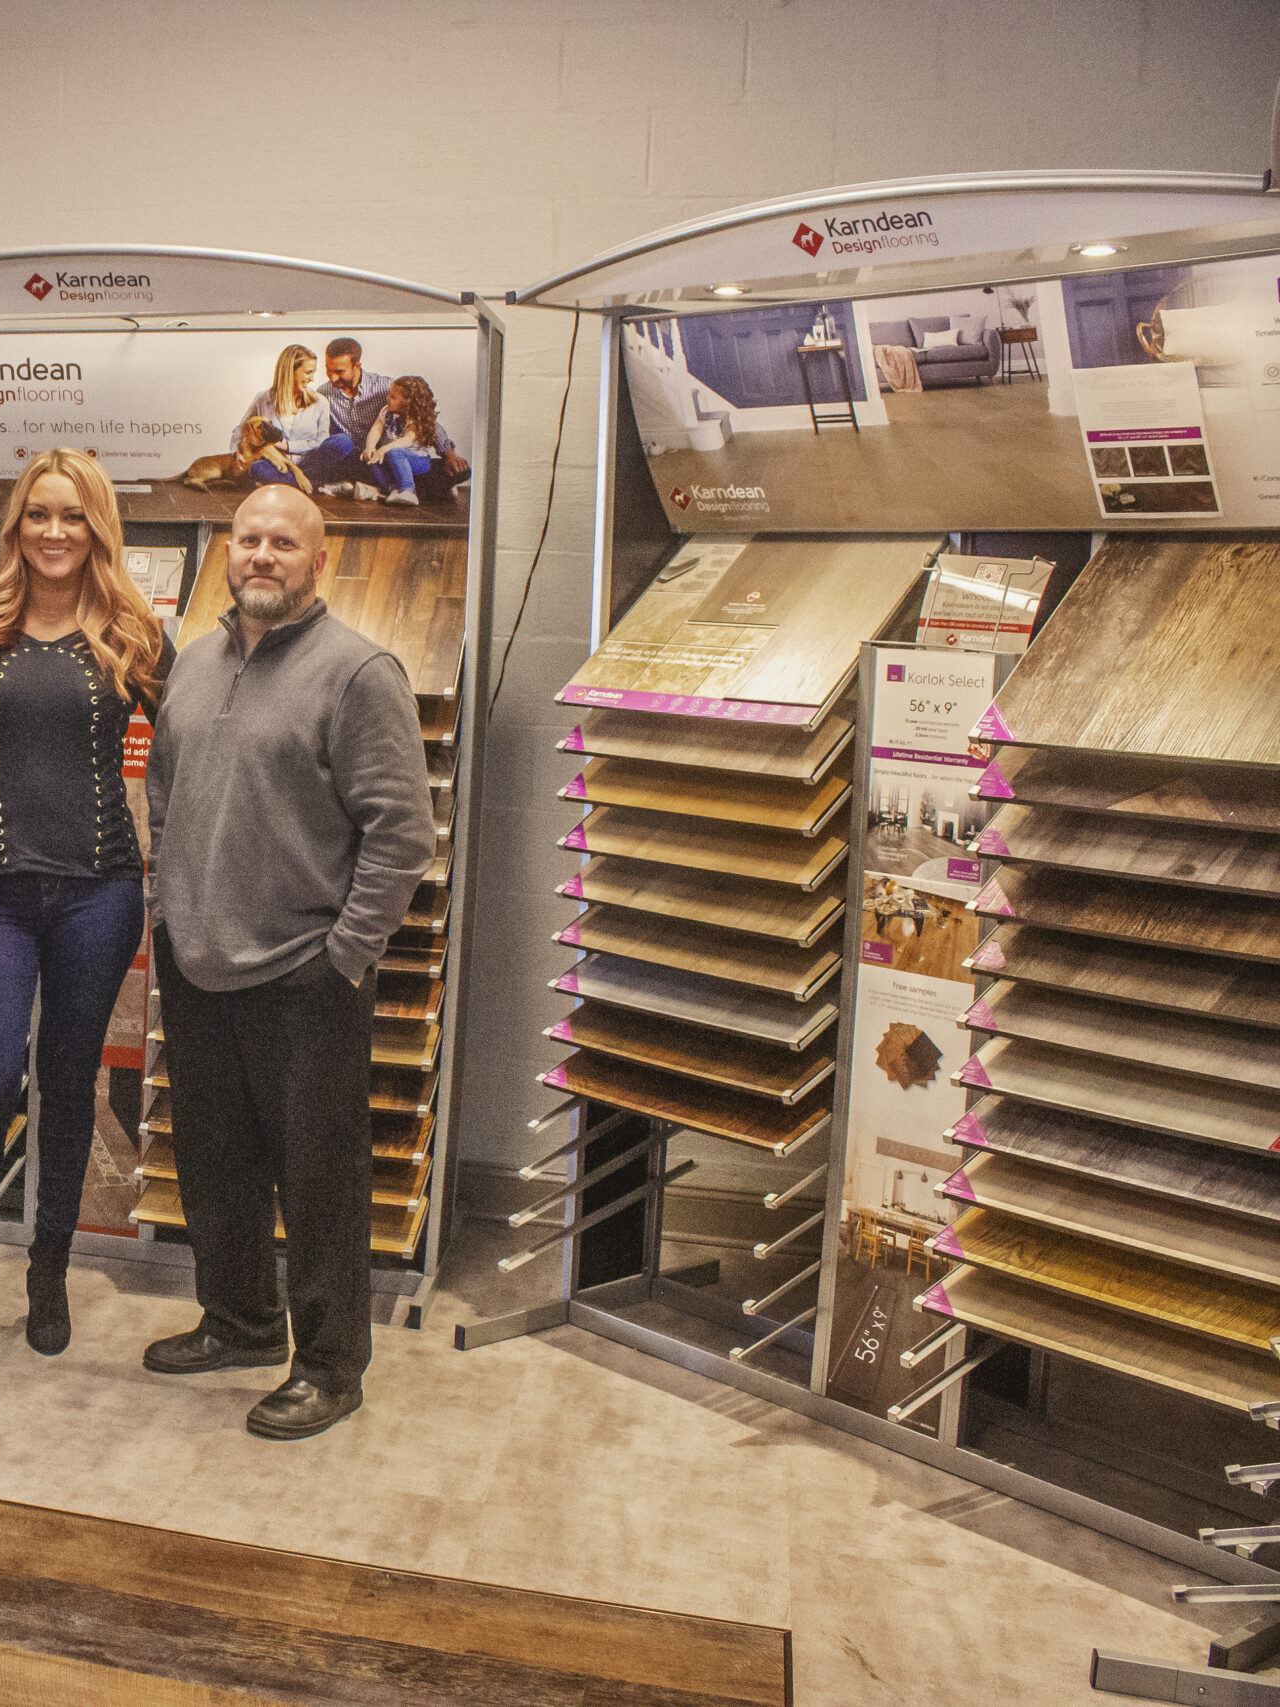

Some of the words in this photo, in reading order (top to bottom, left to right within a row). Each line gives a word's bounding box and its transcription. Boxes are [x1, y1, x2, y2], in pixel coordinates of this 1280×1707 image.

[824, 211, 933, 237] Karndean
[56, 272, 150, 287] Karndean
[51, 420, 95, 433] when
[101, 420, 125, 433] life
[130, 420, 202, 437] happens
[690, 484, 765, 499] Karndean
[908, 672, 945, 686] Korlok
[948, 674, 985, 689] Select
[133, 748, 149, 756] add
[943, 755, 969, 765] Warranty
[892, 981, 908, 991] Free
[909, 986, 937, 997] samples
